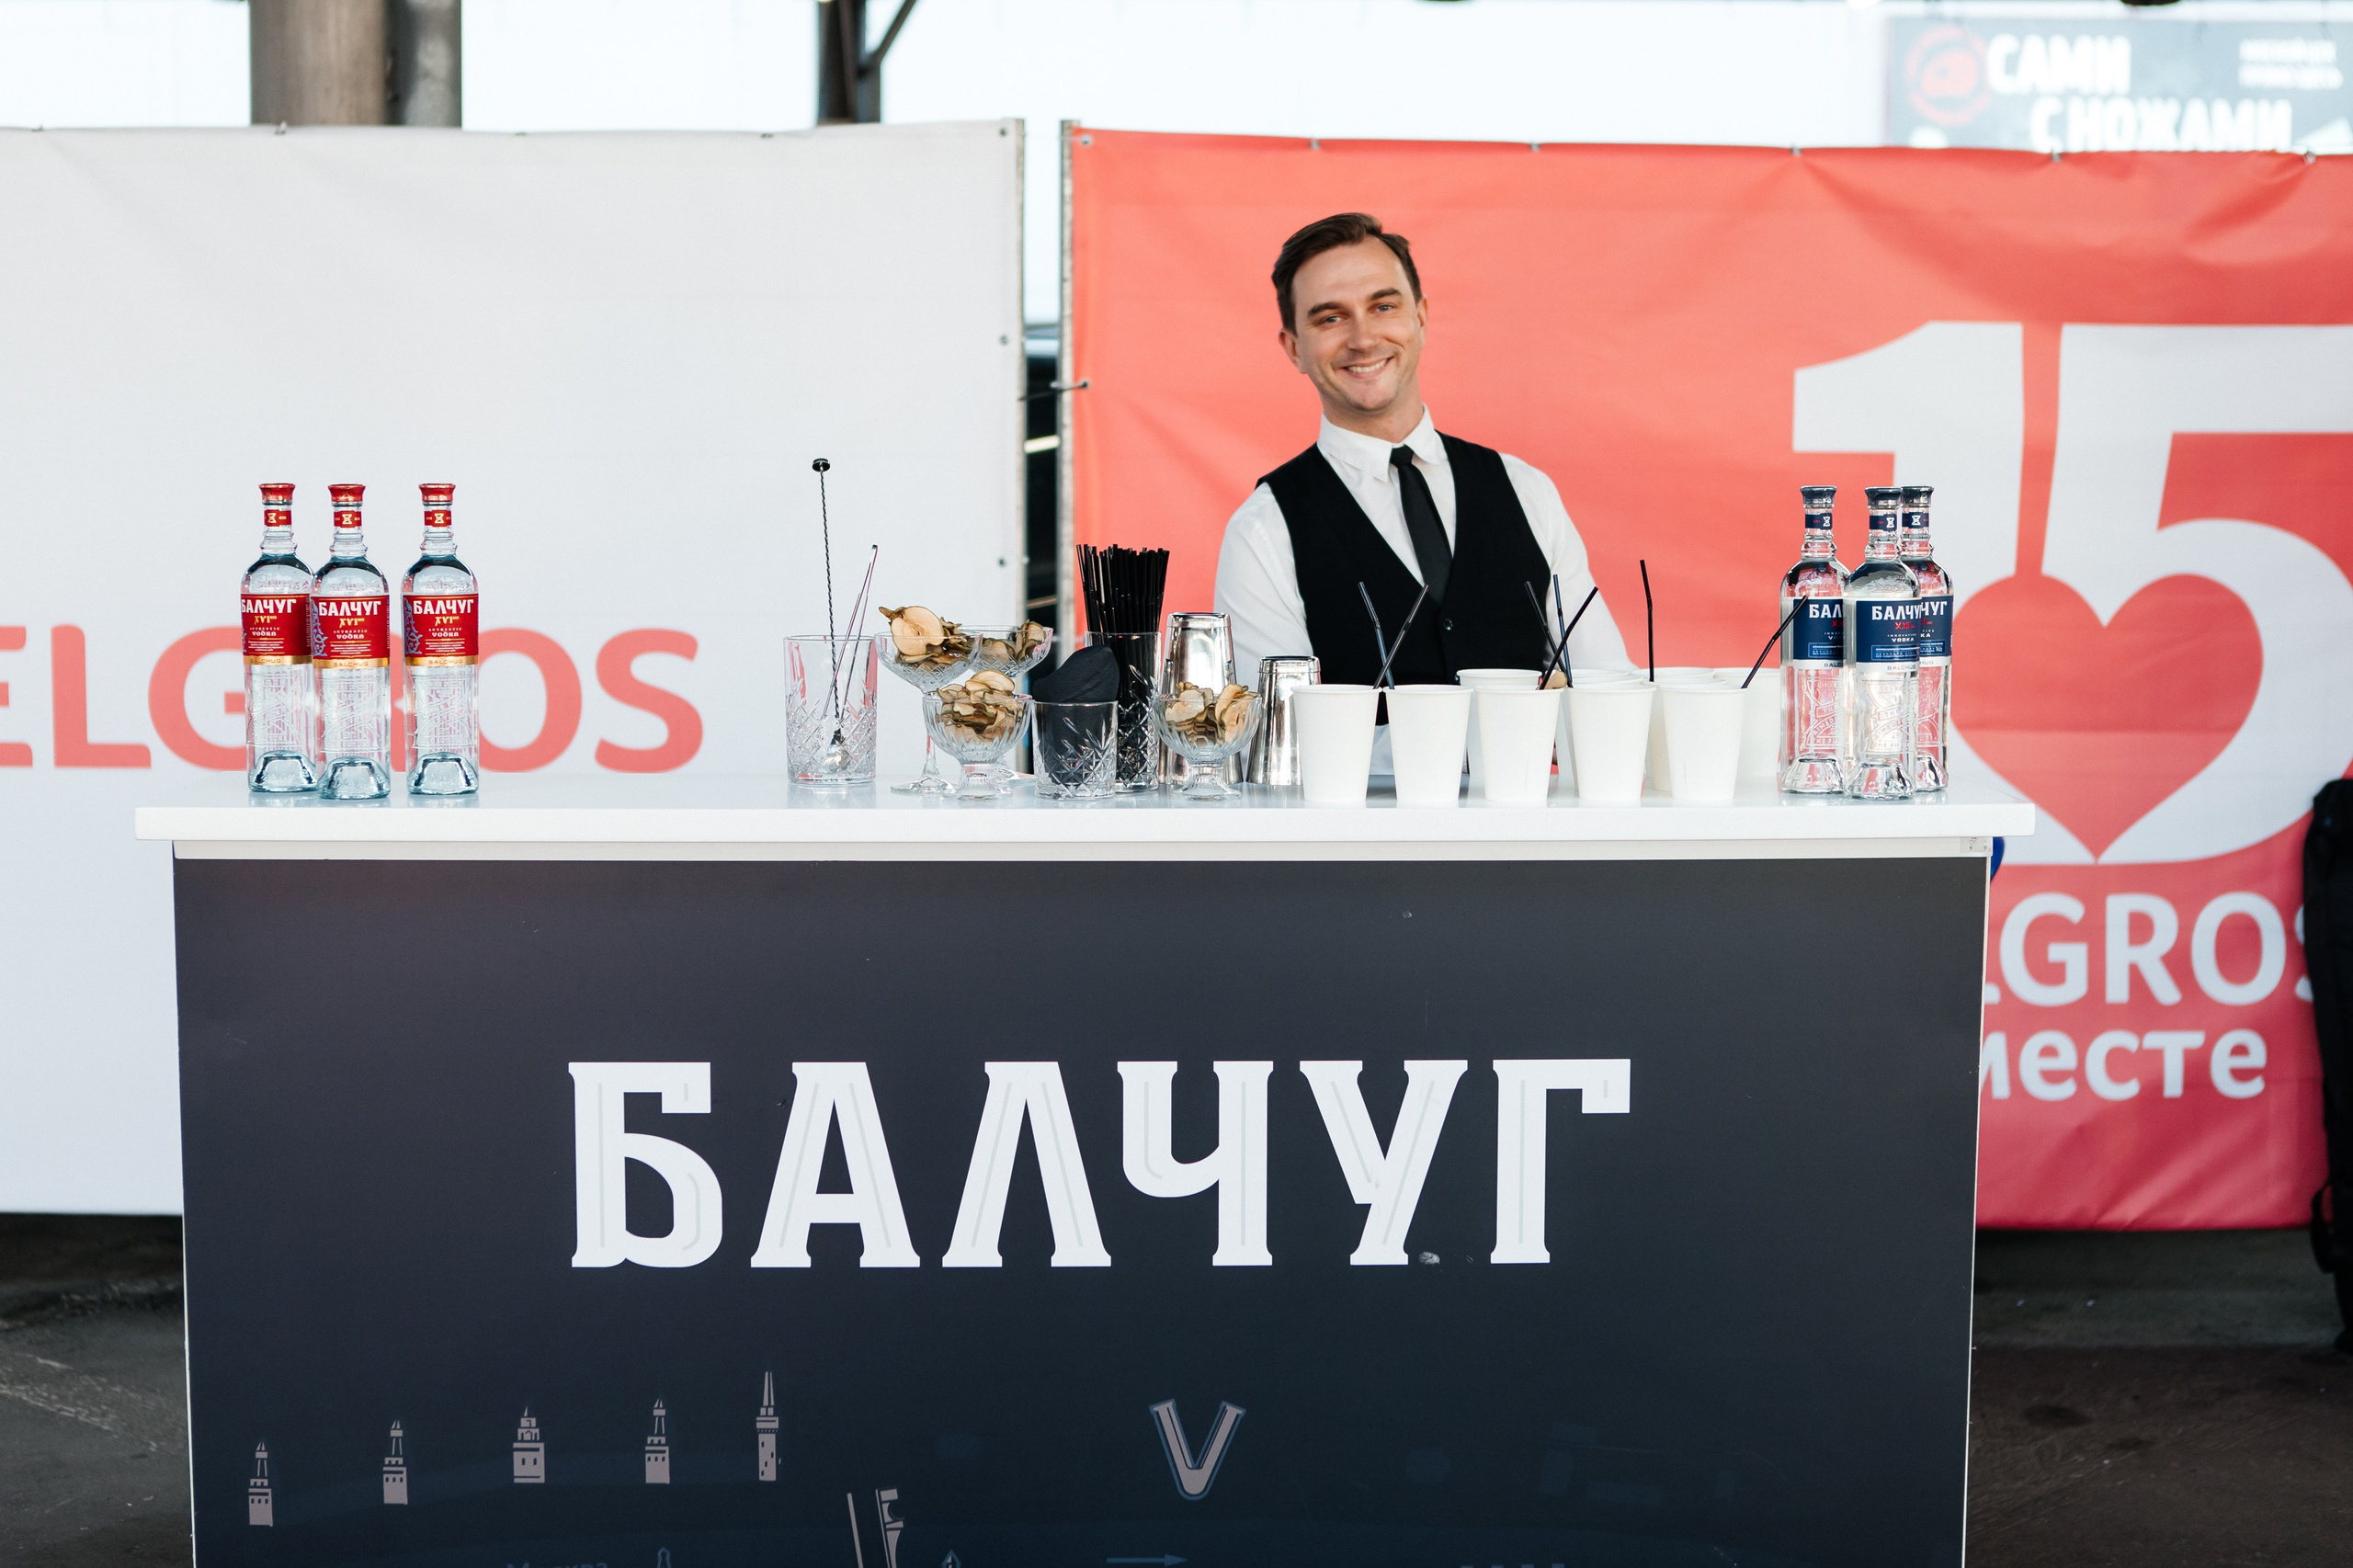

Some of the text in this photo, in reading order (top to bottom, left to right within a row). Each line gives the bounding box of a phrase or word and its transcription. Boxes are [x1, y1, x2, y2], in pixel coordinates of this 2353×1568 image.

[1987, 33, 2131, 93] САМИ
[2066, 97, 2292, 152] НОЖАМИ
[318, 600, 381, 616] БАЛЧУГ
[413, 599, 474, 615] БАЛЧУГ
[1792, 321, 2353, 866] 15
[1809, 604, 1843, 618] БАЛ
[1920, 600, 1948, 616] ЧУГ
[0, 625, 704, 773] LGOS
[1984, 892, 2313, 1006] GRO
[568, 1059, 1631, 1268] БАЛЧУГ
